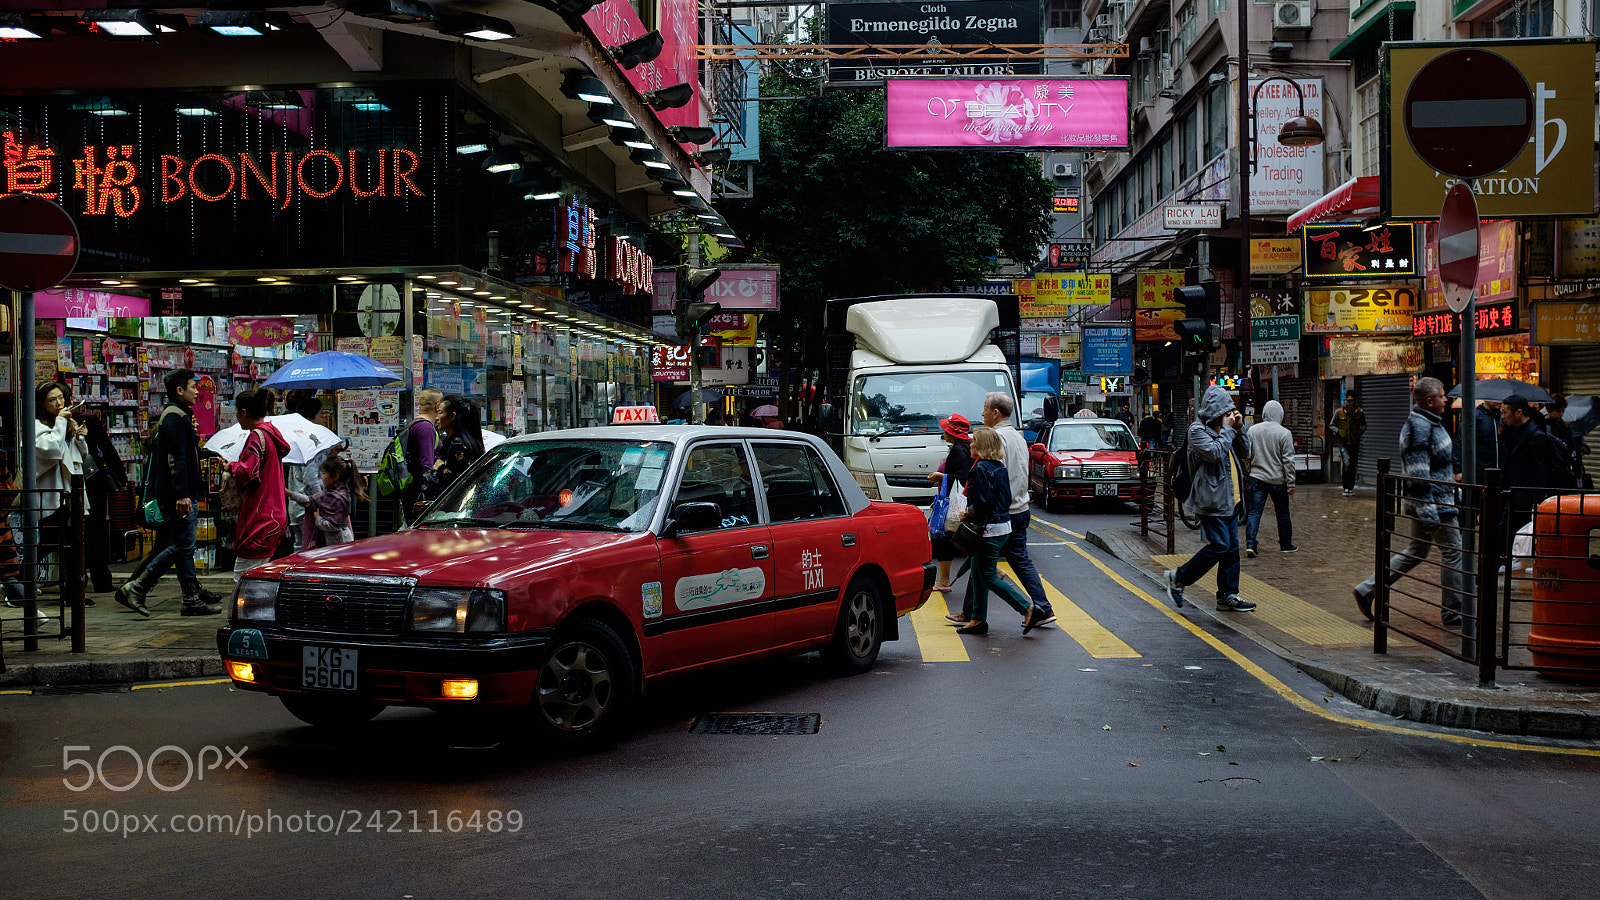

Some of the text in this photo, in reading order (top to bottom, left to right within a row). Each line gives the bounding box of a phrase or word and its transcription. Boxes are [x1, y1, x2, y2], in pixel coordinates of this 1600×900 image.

[920, 4, 947, 13] Cloth
[850, 15, 1018, 34] Ermenegildo Zegna
[1266, 84, 1281, 98] KEE
[1302, 84, 1319, 98] LTD.
[966, 103, 1075, 118] BEAUTY
[963, 121, 981, 132] the
[1026, 121, 1055, 135] shop
[160, 149, 425, 210] BONJOUR
[1262, 165, 1303, 184] Trading
[1444, 177, 1540, 195] SATION
[1167, 209, 1218, 217] RICKY LAU
[1310, 230, 1394, 272] 百家姓
[1384, 309, 1414, 317] Massage
[1250, 317, 1296, 326] TAXI STAND
[1258, 329, 1289, 338] 的士站
[728, 387, 743, 395] LEE
[615, 409, 648, 422] TAXI
[802, 548, 822, 569] 的士
[802, 569, 824, 591] TAXI
[242, 635, 250, 648] 5
[235, 647, 259, 657] SEATS
[318, 647, 342, 668] KG
[304, 667, 354, 689] 5600
